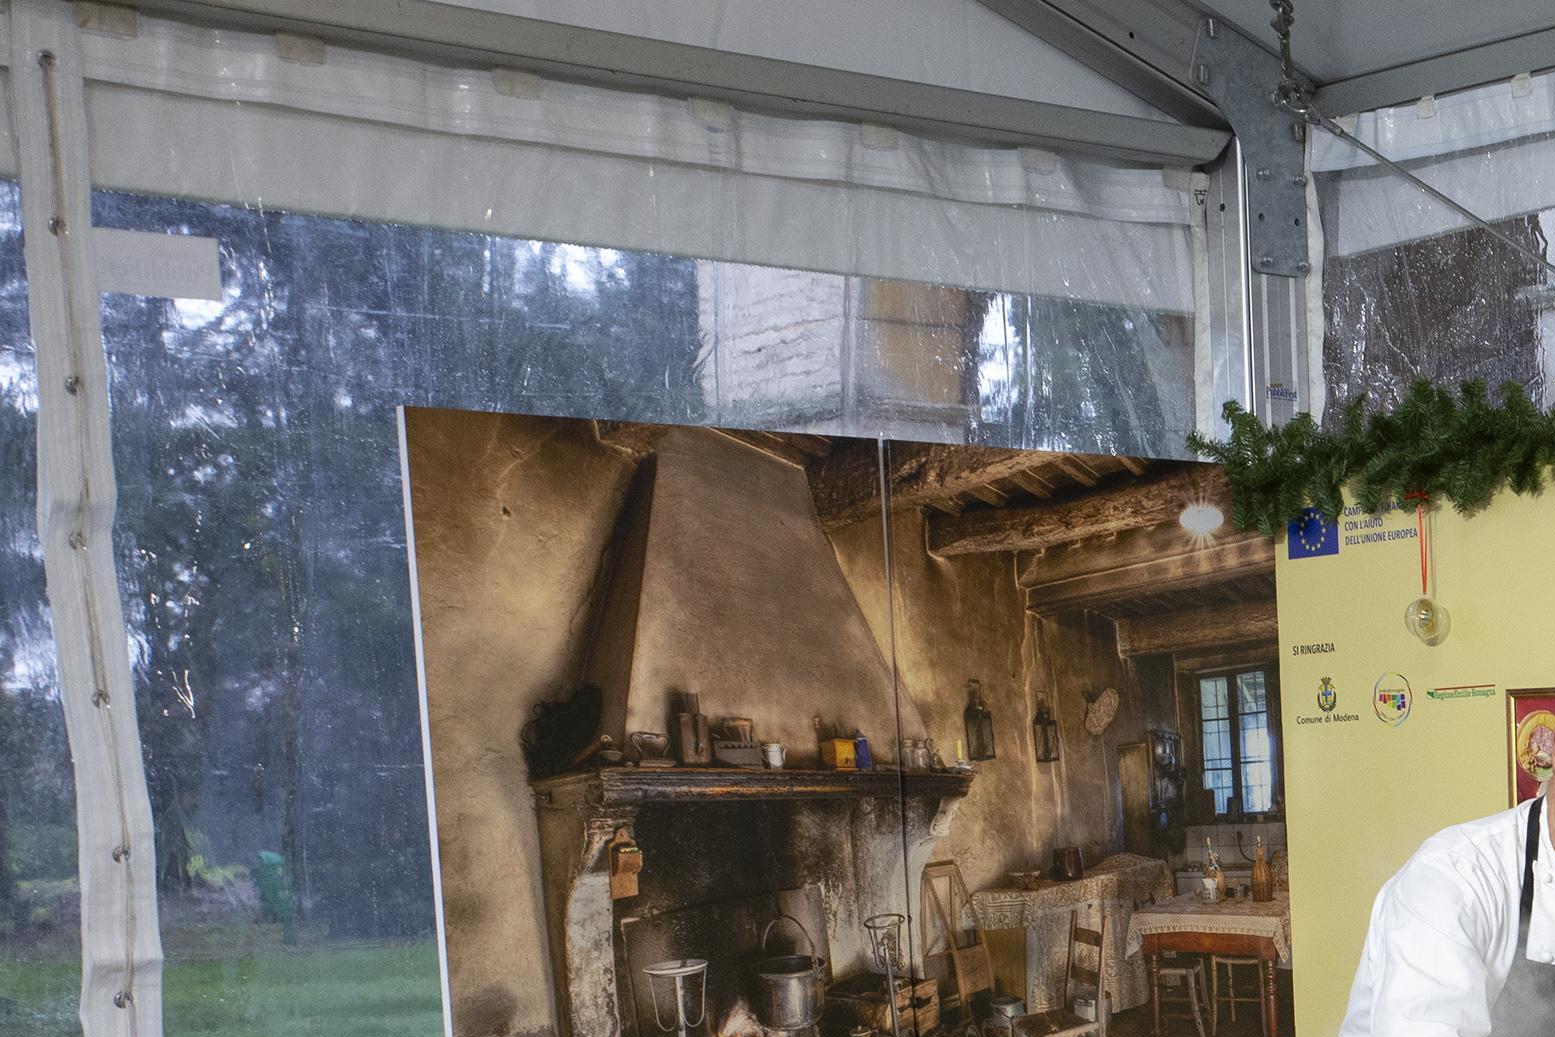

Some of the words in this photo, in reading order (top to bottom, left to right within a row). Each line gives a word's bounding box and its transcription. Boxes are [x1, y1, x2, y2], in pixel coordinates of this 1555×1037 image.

[1345, 521, 1359, 531] CON
[1360, 518, 1383, 530] L'AIUTO
[1345, 532, 1387, 545] DELL'UNIONE
[1388, 528, 1418, 540] EUROPEA
[1292, 646, 1299, 656] SI
[1300, 643, 1336, 655] RINGRAZIA
[1297, 716, 1323, 725] Comune
[1325, 713, 1332, 723] di
[1333, 713, 1360, 722] Modena
